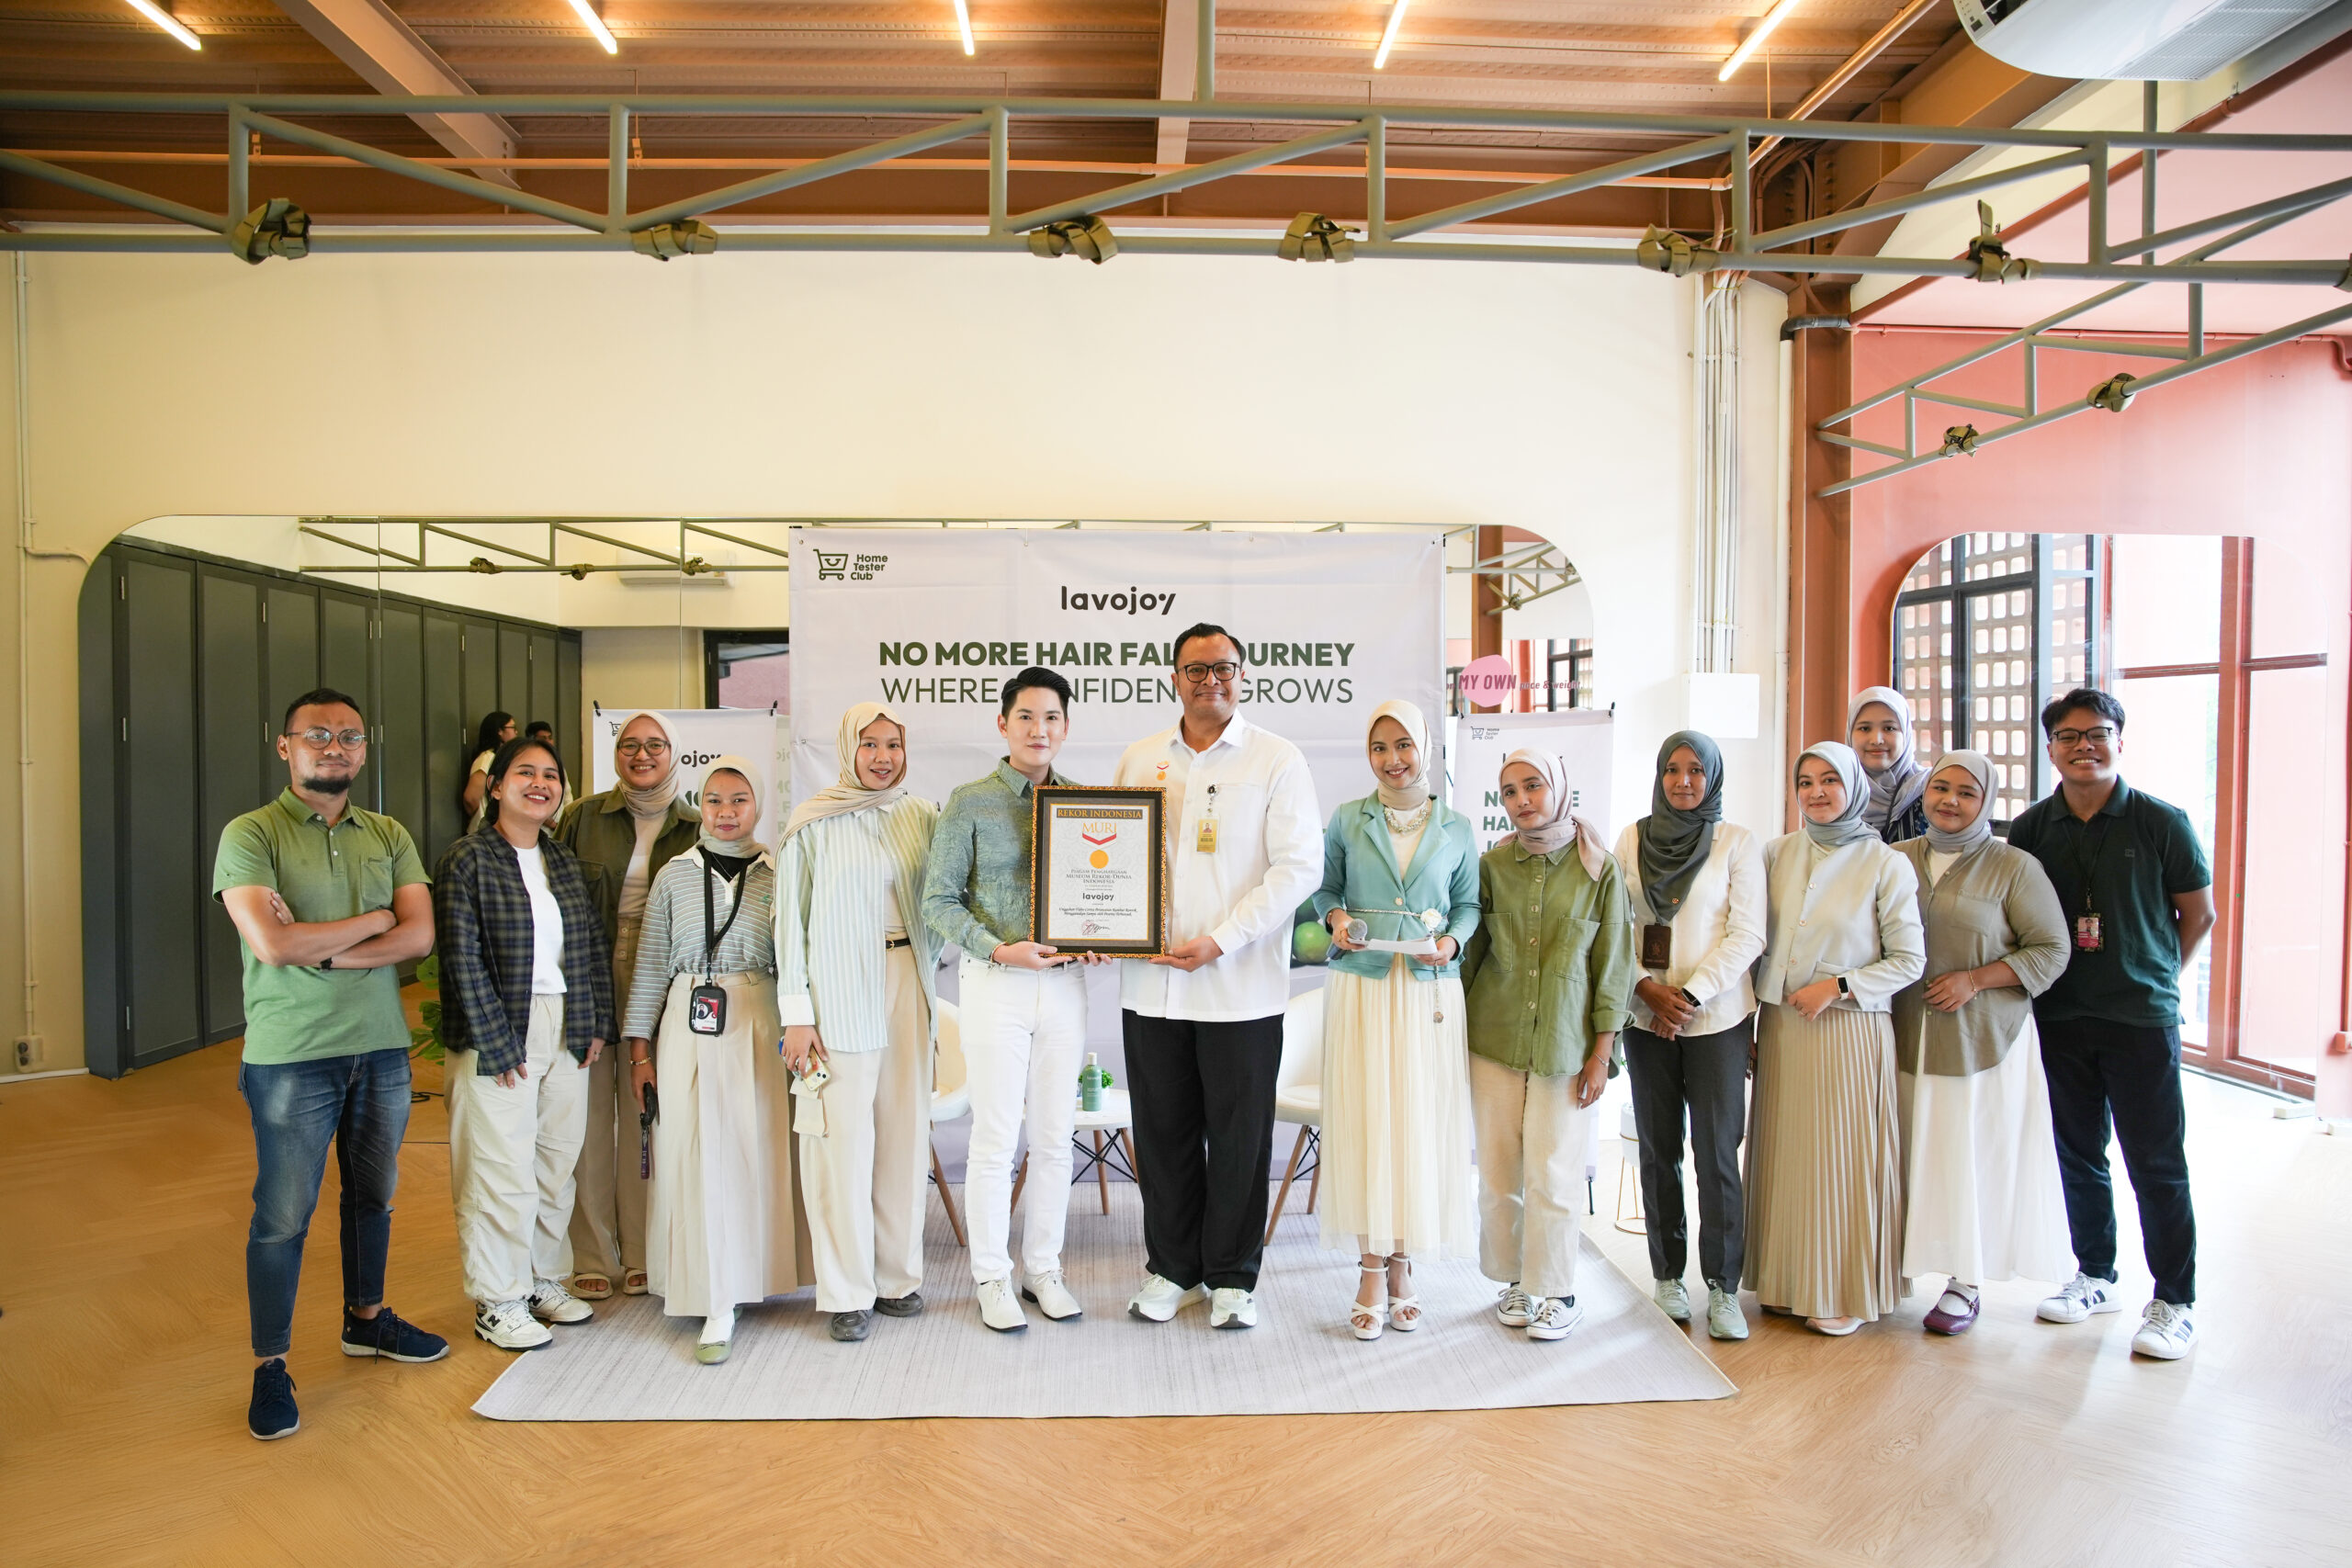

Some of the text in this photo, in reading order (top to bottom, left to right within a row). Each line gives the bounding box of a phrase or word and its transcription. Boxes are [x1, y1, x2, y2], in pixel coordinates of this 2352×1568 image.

[857, 554, 888, 562] Home
[854, 563, 885, 571] Tester
[851, 572, 873, 581] Club
[1061, 585, 1176, 615] lavojoy
[879, 642, 1355, 667] NO MORE HAIR FAL URNEY
[1459, 675, 1479, 690] MY
[1484, 675, 1517, 690] OWN
[880, 678, 999, 703] WHERE
[1090, 810, 1142, 818] INDONESIA
[1082, 822, 1116, 833] MURI
[1082, 892, 1114, 901] lavojoy
